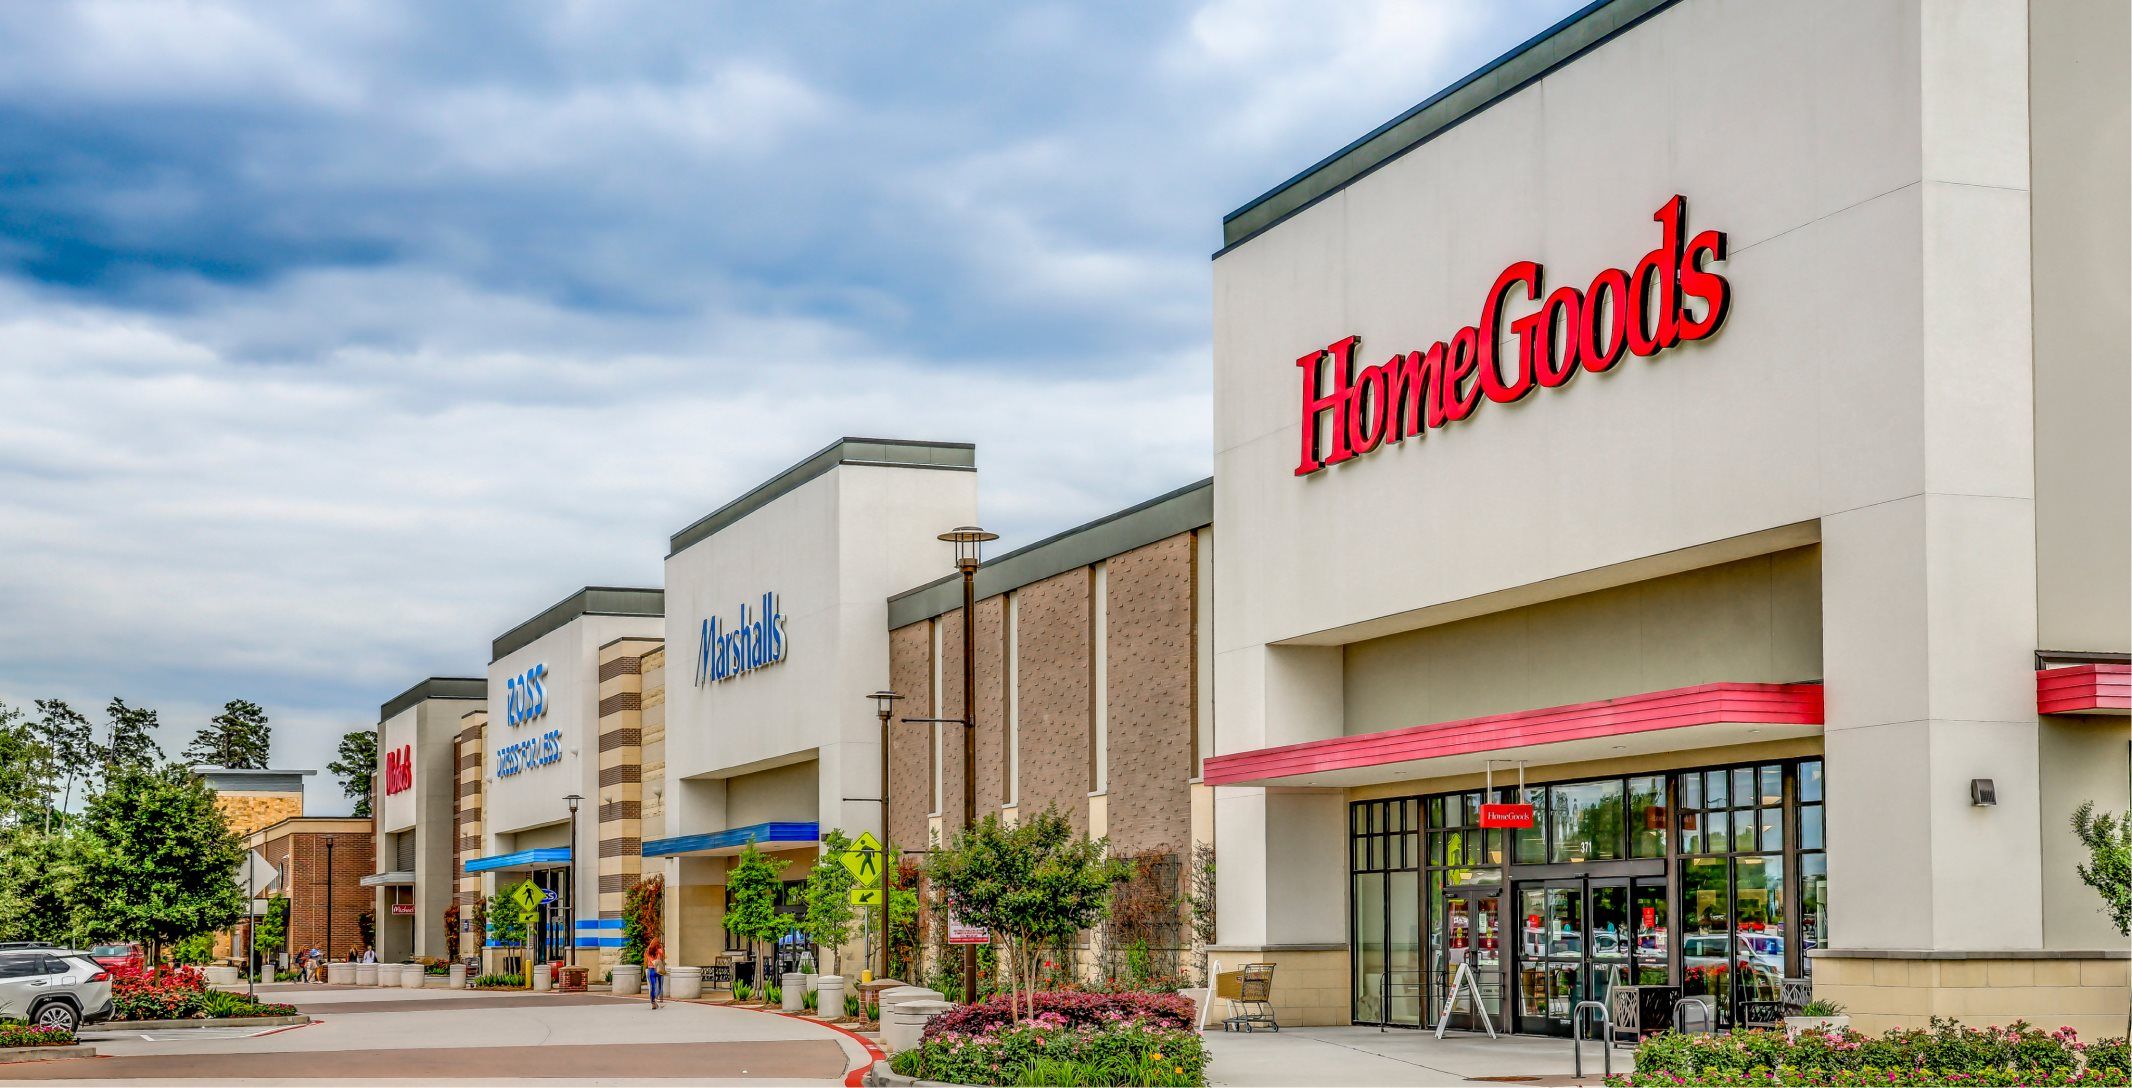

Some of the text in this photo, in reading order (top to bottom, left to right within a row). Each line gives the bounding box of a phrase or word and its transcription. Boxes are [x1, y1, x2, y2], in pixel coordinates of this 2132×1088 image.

[1294, 194, 1731, 478] HomeGoods
[694, 591, 787, 688] Marshalls
[507, 664, 548, 727] ROSS
[496, 744, 522, 778] DRESS
[537, 729, 562, 766] LESS
[1487, 810, 1530, 821] HomeGoods
[1580, 840, 1592, 854] 371
